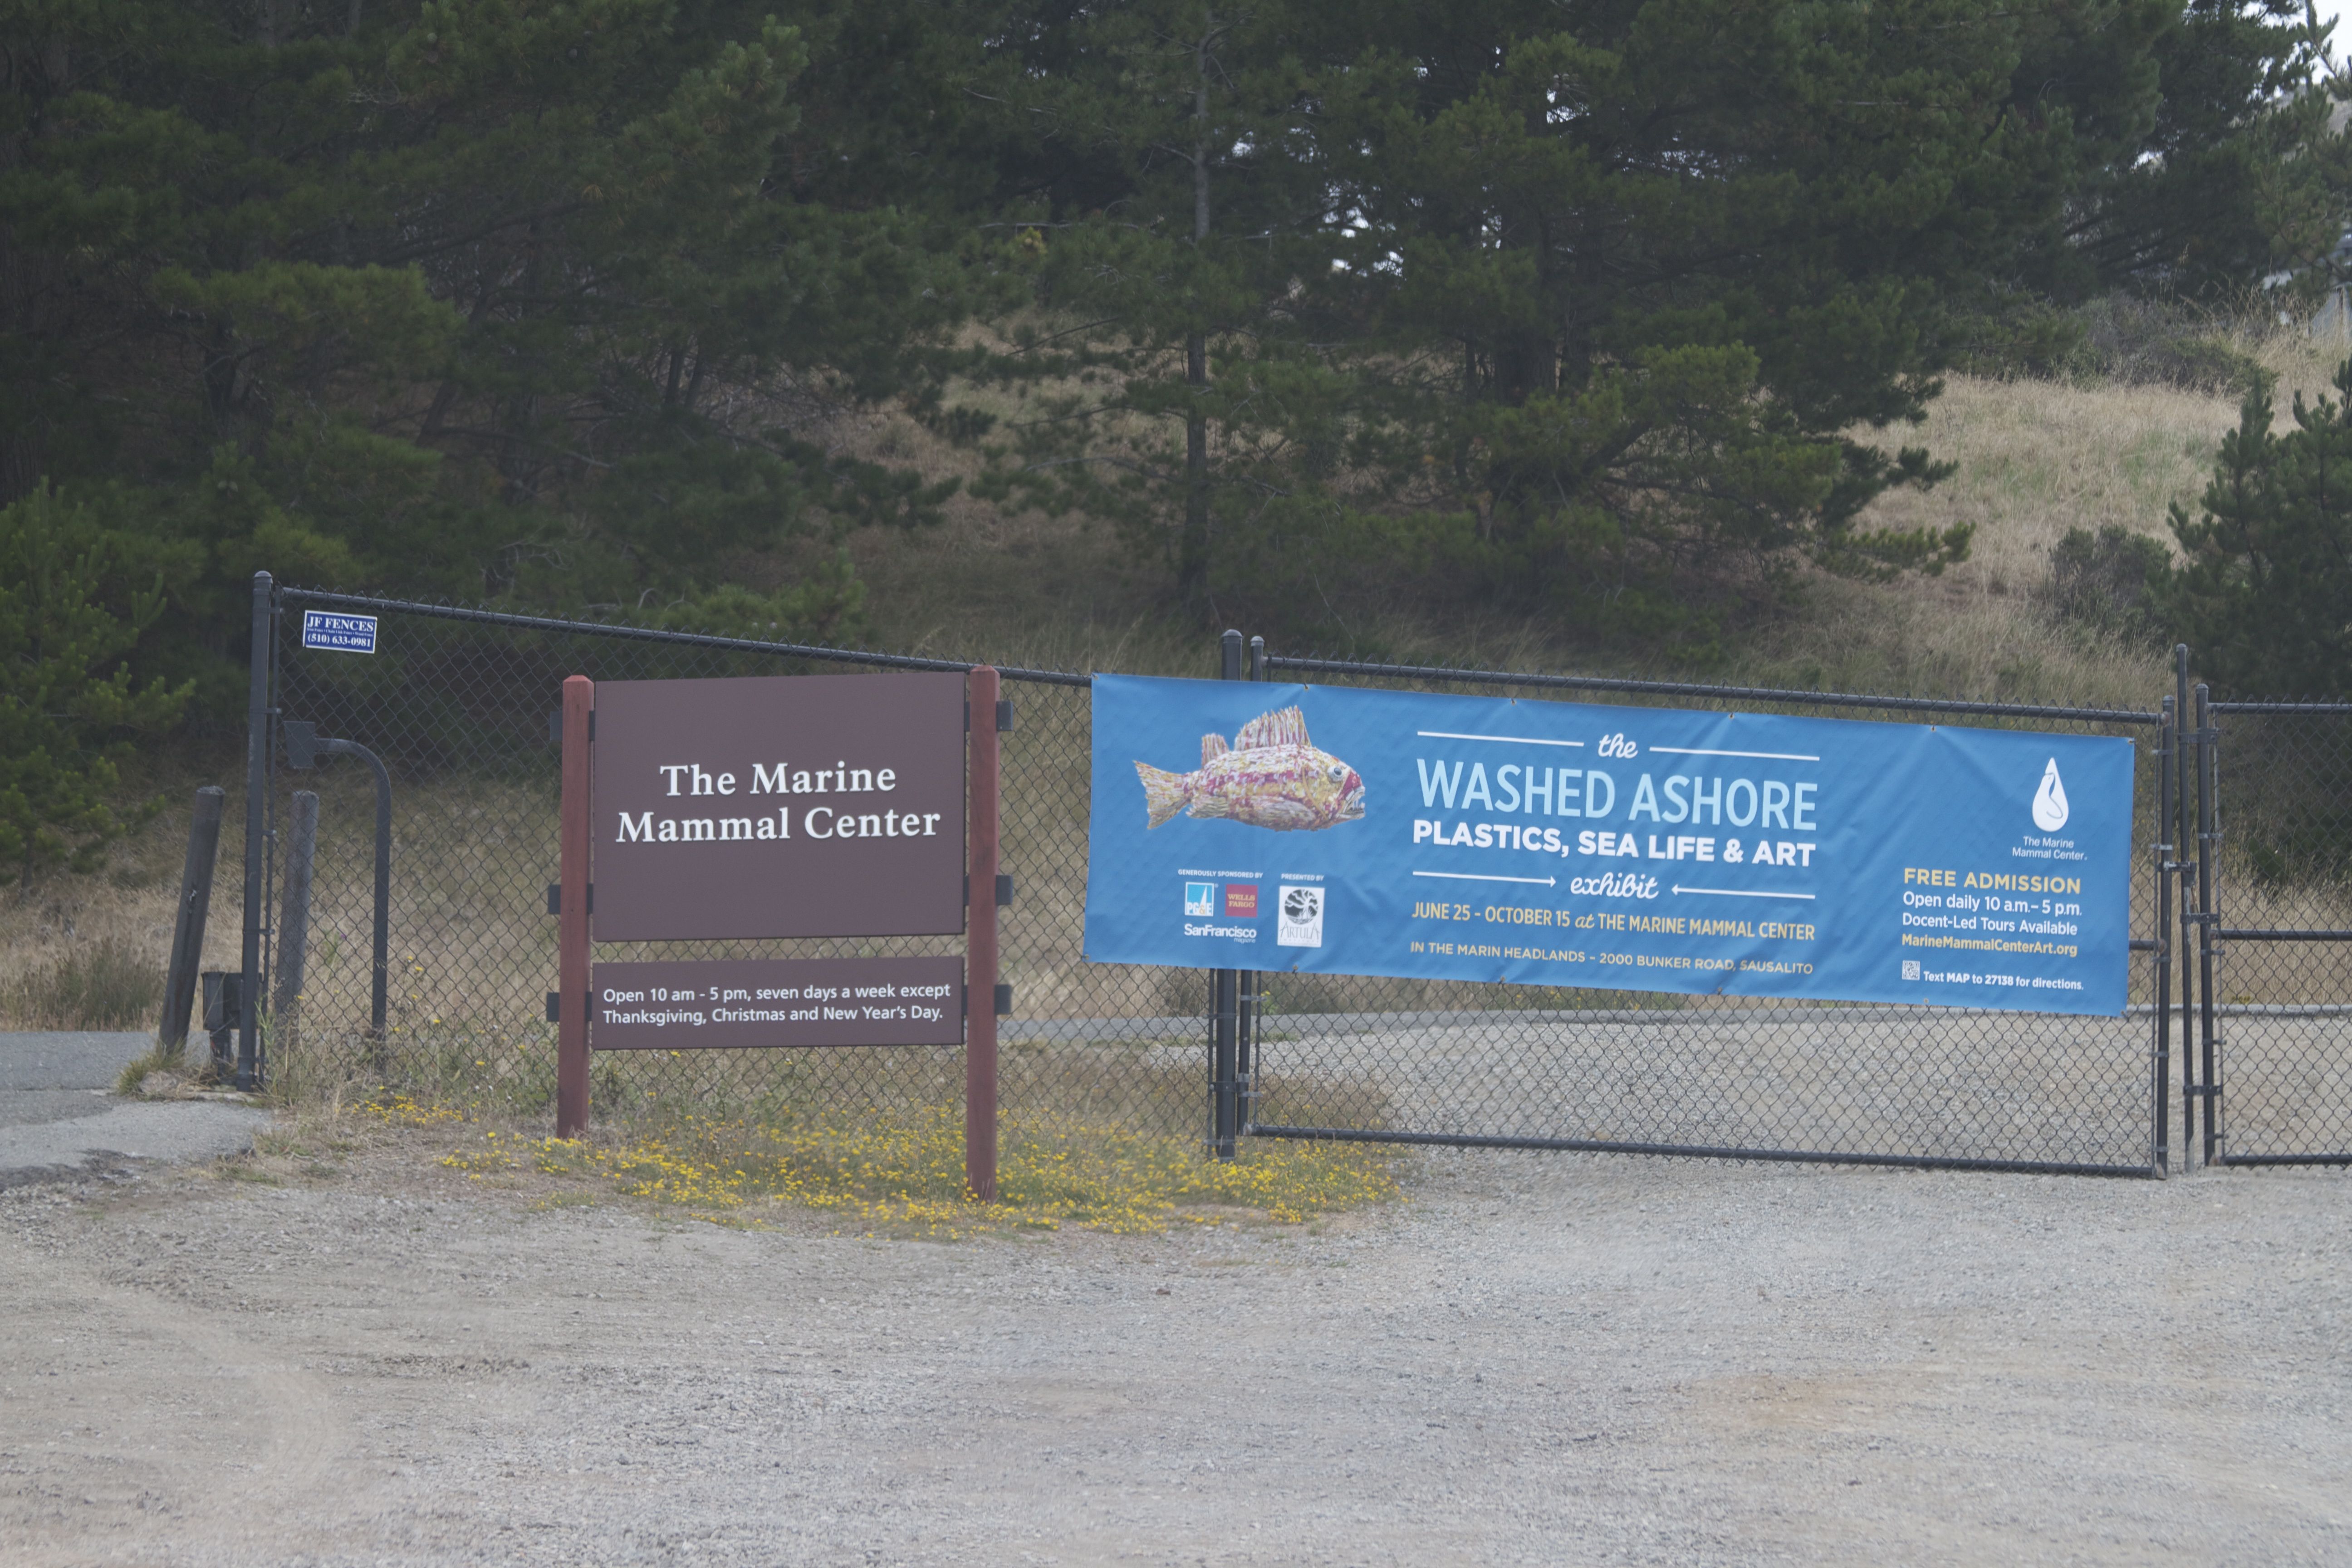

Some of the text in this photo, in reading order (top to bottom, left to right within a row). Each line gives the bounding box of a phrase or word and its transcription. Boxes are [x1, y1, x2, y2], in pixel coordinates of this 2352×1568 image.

[308, 616, 373, 632] JF FENCES
[308, 632, 370, 647] (510) 633-0981
[1598, 733, 1638, 759] the
[660, 761, 896, 796] The Marine
[1416, 759, 1818, 831] WASHED ASHORE
[616, 807, 941, 843] Mammal Center
[1413, 820, 1815, 867] PLASTICS, SEA LIFE & ART
[2013, 847, 2051, 859] Mammal
[2023, 836, 2074, 848] The Marine
[1570, 872, 1659, 900] exhibit
[1904, 868, 2081, 894] FREE ADMISSION
[1187, 902, 1212, 914] PG&E
[1903, 891, 1941, 909] Open
[1946, 893, 1980, 912] daily
[1984, 897, 2000, 911] 10
[2042, 900, 2050, 913] 5
[2055, 902, 2082, 917] p.m.
[1184, 923, 1256, 938] SanFrancisco
[1412, 902, 1449, 920] JUNE
[1453, 905, 1470, 921] 25
[1485, 906, 1553, 926] OCTOBER
[1556, 911, 1571, 926] 15
[1575, 914, 1595, 929] at
[1598, 913, 1625, 931] THE
[1629, 915, 1686, 934] MARINE
[1690, 920, 1755, 937] MAMMAL
[1759, 922, 1814, 940] CENTER
[1903, 913, 2078, 935] Docent-Led Tours Available
[1902, 934, 2078, 957] MarineMammalCenterArt.org
[1411, 941, 1424, 953] IN
[1428, 942, 1454, 955] THE
[1457, 945, 1500, 957] MARIN
[1504, 947, 1585, 962] HEADLANDS
[1600, 952, 1633, 965] 2000
[1637, 955, 1690, 968] BUNKER
[1695, 957, 1736, 971] ROAD,
[1739, 960, 1813, 974] SAUSALITO
[1924, 971, 2084, 990] Text MAP to 27138 for directions.
[603, 988, 643, 1005] Open
[650, 988, 667, 1001] 10
[671, 990, 695, 1001] am
[710, 987, 718, 1000] 5
[724, 989, 751, 1002] pm,
[756, 988, 799, 999] seven
[804, 985, 837, 1001] days
[842, 987, 850, 998] a
[855, 984, 896, 998] week
[900, 984, 951, 1000] except
[603, 1008, 707, 1026] Thanksgiving,
[712, 1007, 785, 1022] Christmas
[790, 1007, 818, 1020] and
[823, 1007, 858, 1020] New
[911, 1005, 943, 1022] Day.
